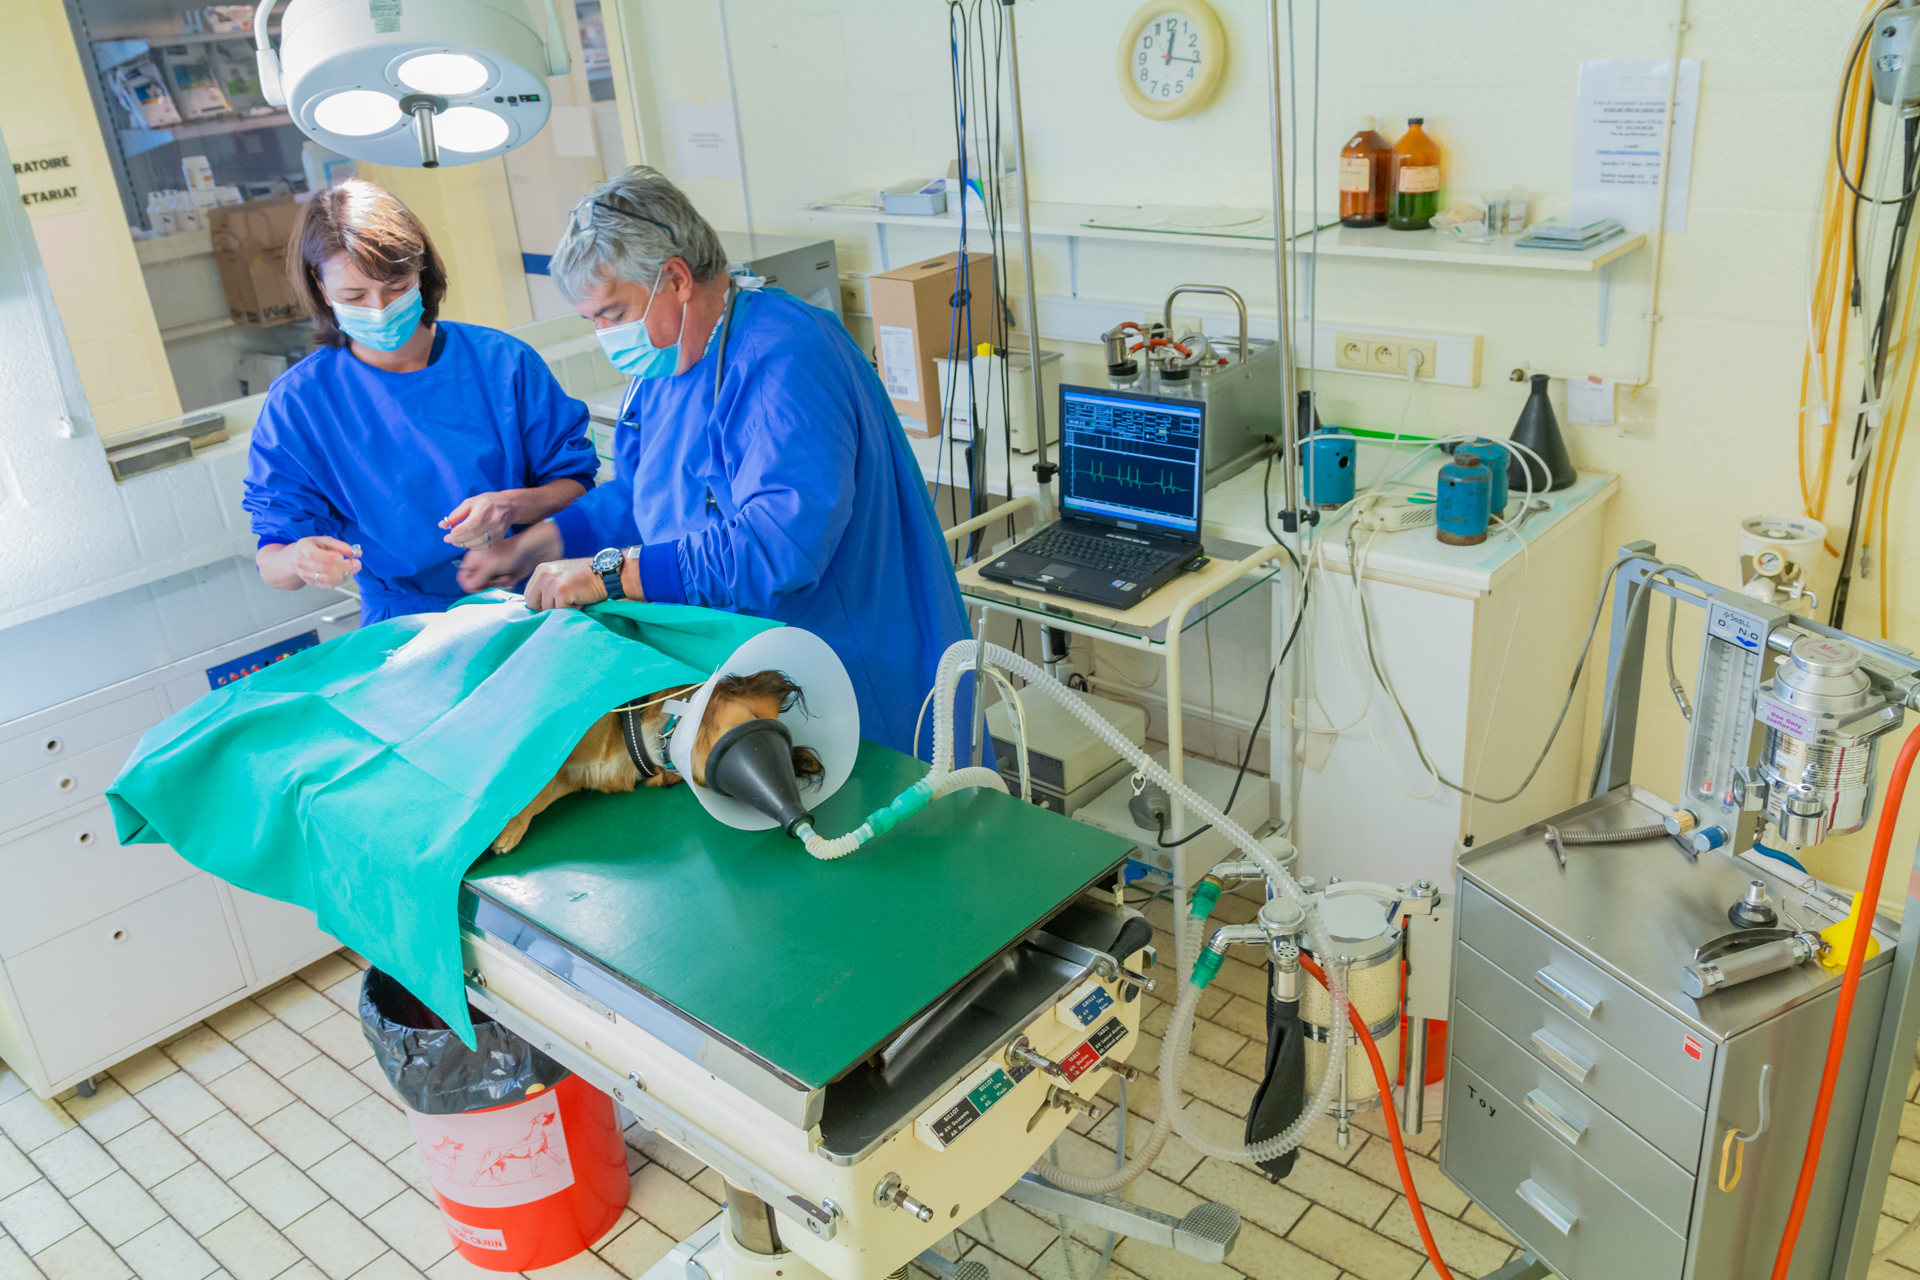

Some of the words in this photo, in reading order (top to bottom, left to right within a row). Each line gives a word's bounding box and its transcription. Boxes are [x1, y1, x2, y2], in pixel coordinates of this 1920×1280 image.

[1154, 22, 1161, 36] 11
[1165, 18, 1178, 32] 12
[1183, 21, 1187, 35] 1
[1143, 35, 1153, 49] 10
[1188, 33, 1197, 48] 2
[1138, 51, 1147, 66] 9
[1192, 50, 1200, 62] 3
[1140, 68, 1149, 82] 8
[1186, 66, 1194, 80] 4
[1150, 80, 1158, 94] 7
[1161, 83, 1170, 97] 6
[1175, 80, 1183, 93] 5
[12, 155, 71, 174] RATOIRE
[21, 186, 78, 206] ETARIAT
[1766, 715, 1803, 736] Isoflurane
[1771, 711, 1785, 722] Use
[1785, 718, 1802, 729] Only
[1082, 994, 1097, 1008] GRILLE
[1097, 1025, 1110, 1037] TABLE
[1068, 1050, 1081, 1063] TABLE
[978, 1077, 994, 1092] BILLOT
[1467, 1084, 1496, 1117] Toy
[943, 1107, 960, 1122] BILLOT
[470, 1236, 503, 1248] CANIN
